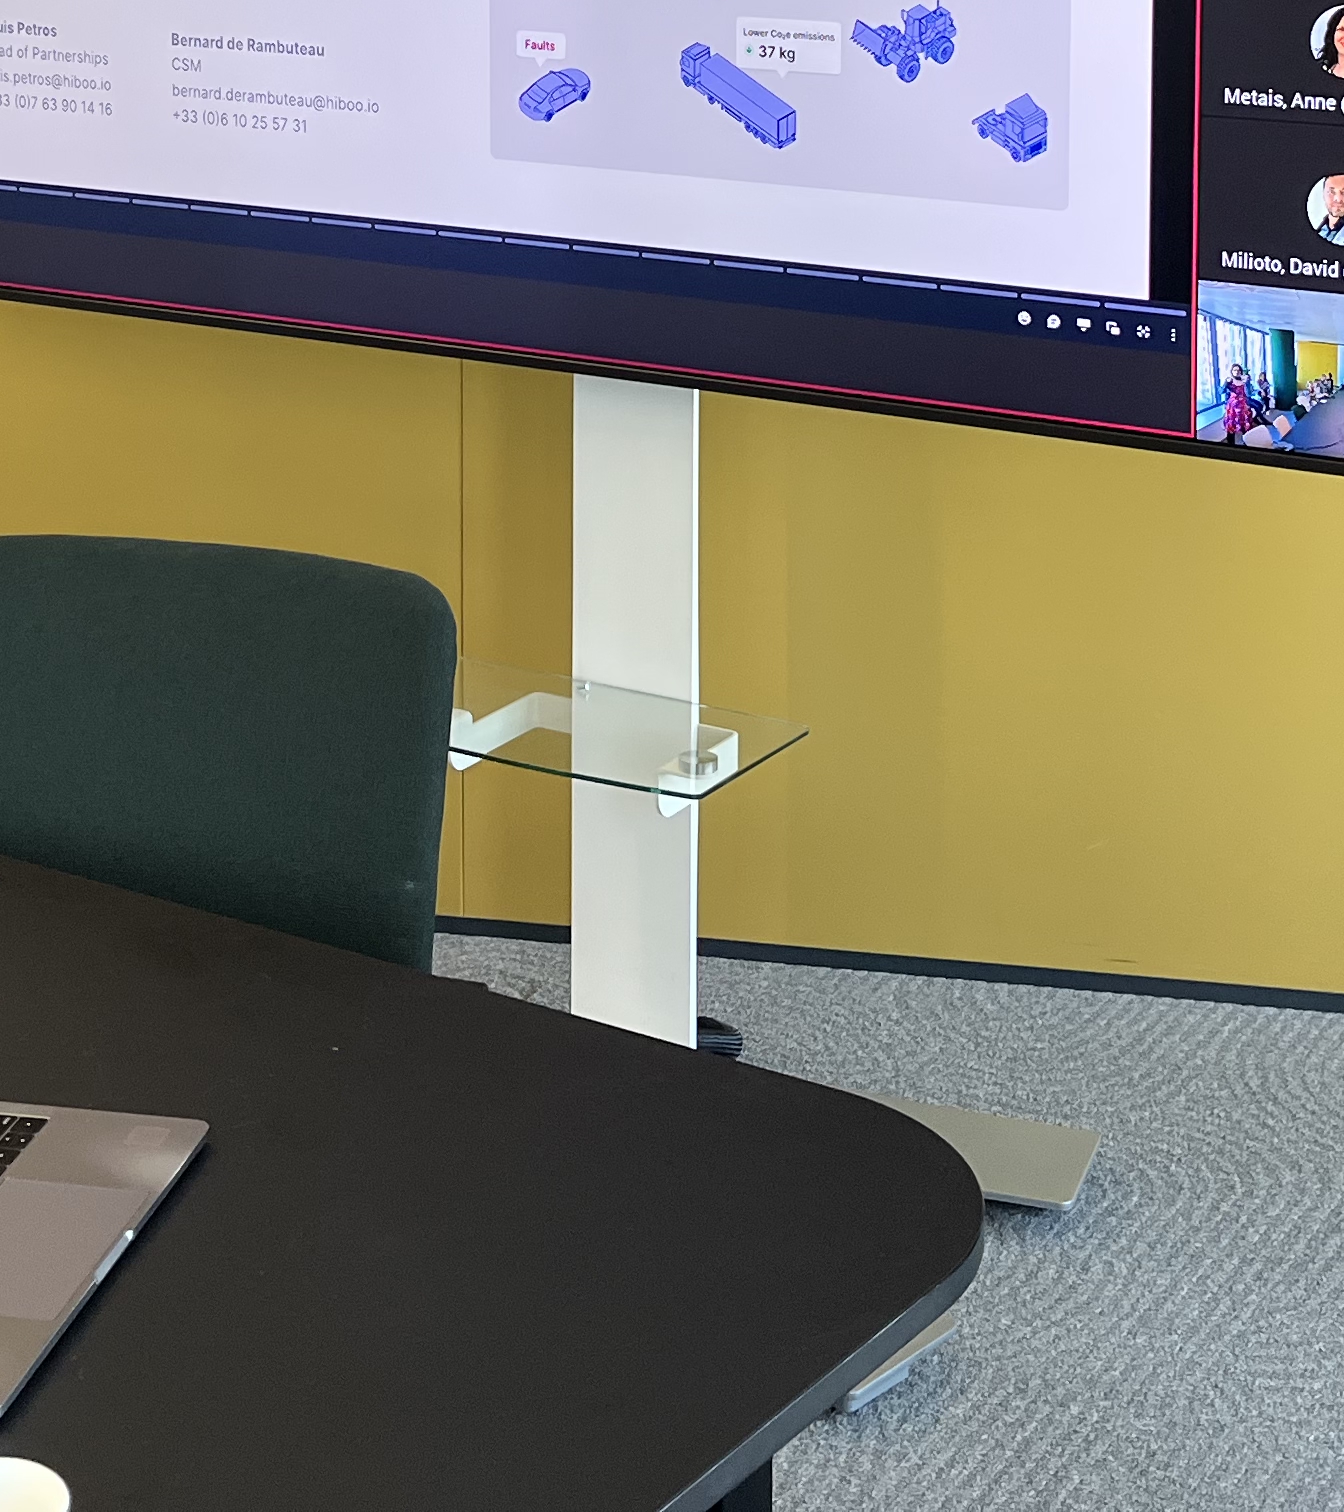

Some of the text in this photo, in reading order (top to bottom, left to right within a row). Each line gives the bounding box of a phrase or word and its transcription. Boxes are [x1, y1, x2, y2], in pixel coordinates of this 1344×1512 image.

[17, 21, 57, 37] Petros
[743, 28, 769, 39] Lower
[792, 31, 836, 42] emissions
[171, 33, 325, 57] Bernard de Rambuteau
[525, 39, 555, 52] Faults
[758, 45, 796, 63] 37 kg
[17, 45, 29, 59] of
[32, 46, 109, 67] Partnerships
[171, 57, 202, 72] CSM
[42, 97, 57, 111] 63
[61, 98, 77, 113] 90
[81, 100, 95, 115] 14
[99, 102, 113, 116] 16
[1224, 88, 1287, 110] Metais,
[1290, 91, 1336, 111] Anne
[173, 109, 198, 124] +33
[232, 113, 247, 128] 10
[252, 115, 268, 130] 25
[272, 117, 288, 132] 57
[292, 118, 307, 133] 31
[1221, 251, 1286, 275] Milioto,
[1289, 257, 1339, 279] David
